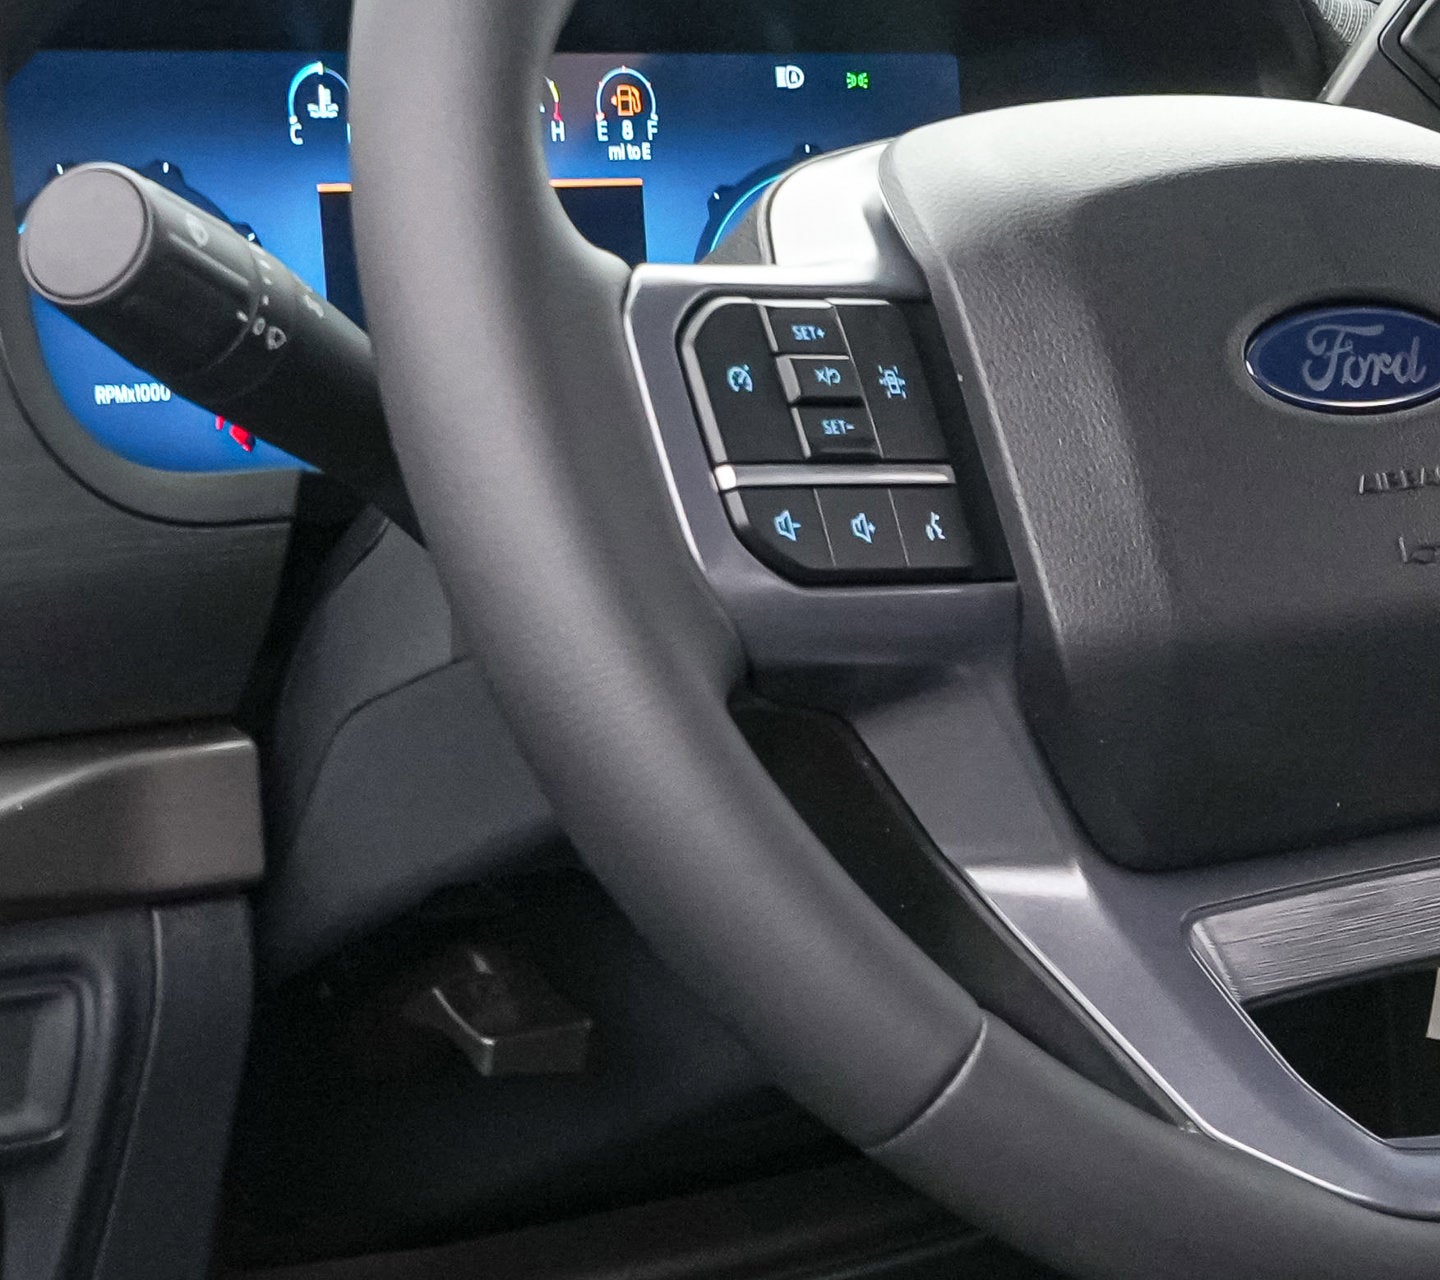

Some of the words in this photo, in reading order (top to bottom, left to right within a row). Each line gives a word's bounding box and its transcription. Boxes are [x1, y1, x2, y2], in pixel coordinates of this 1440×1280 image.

[290, 123, 304, 145] C
[551, 121, 565, 142] H
[597, 120, 609, 141] E
[622, 119, 634, 141] 8
[647, 120, 658, 141] F
[608, 142, 626, 161] mi
[626, 142, 641, 161] to
[641, 142, 652, 161] E
[1302, 323, 1427, 392] Ford
